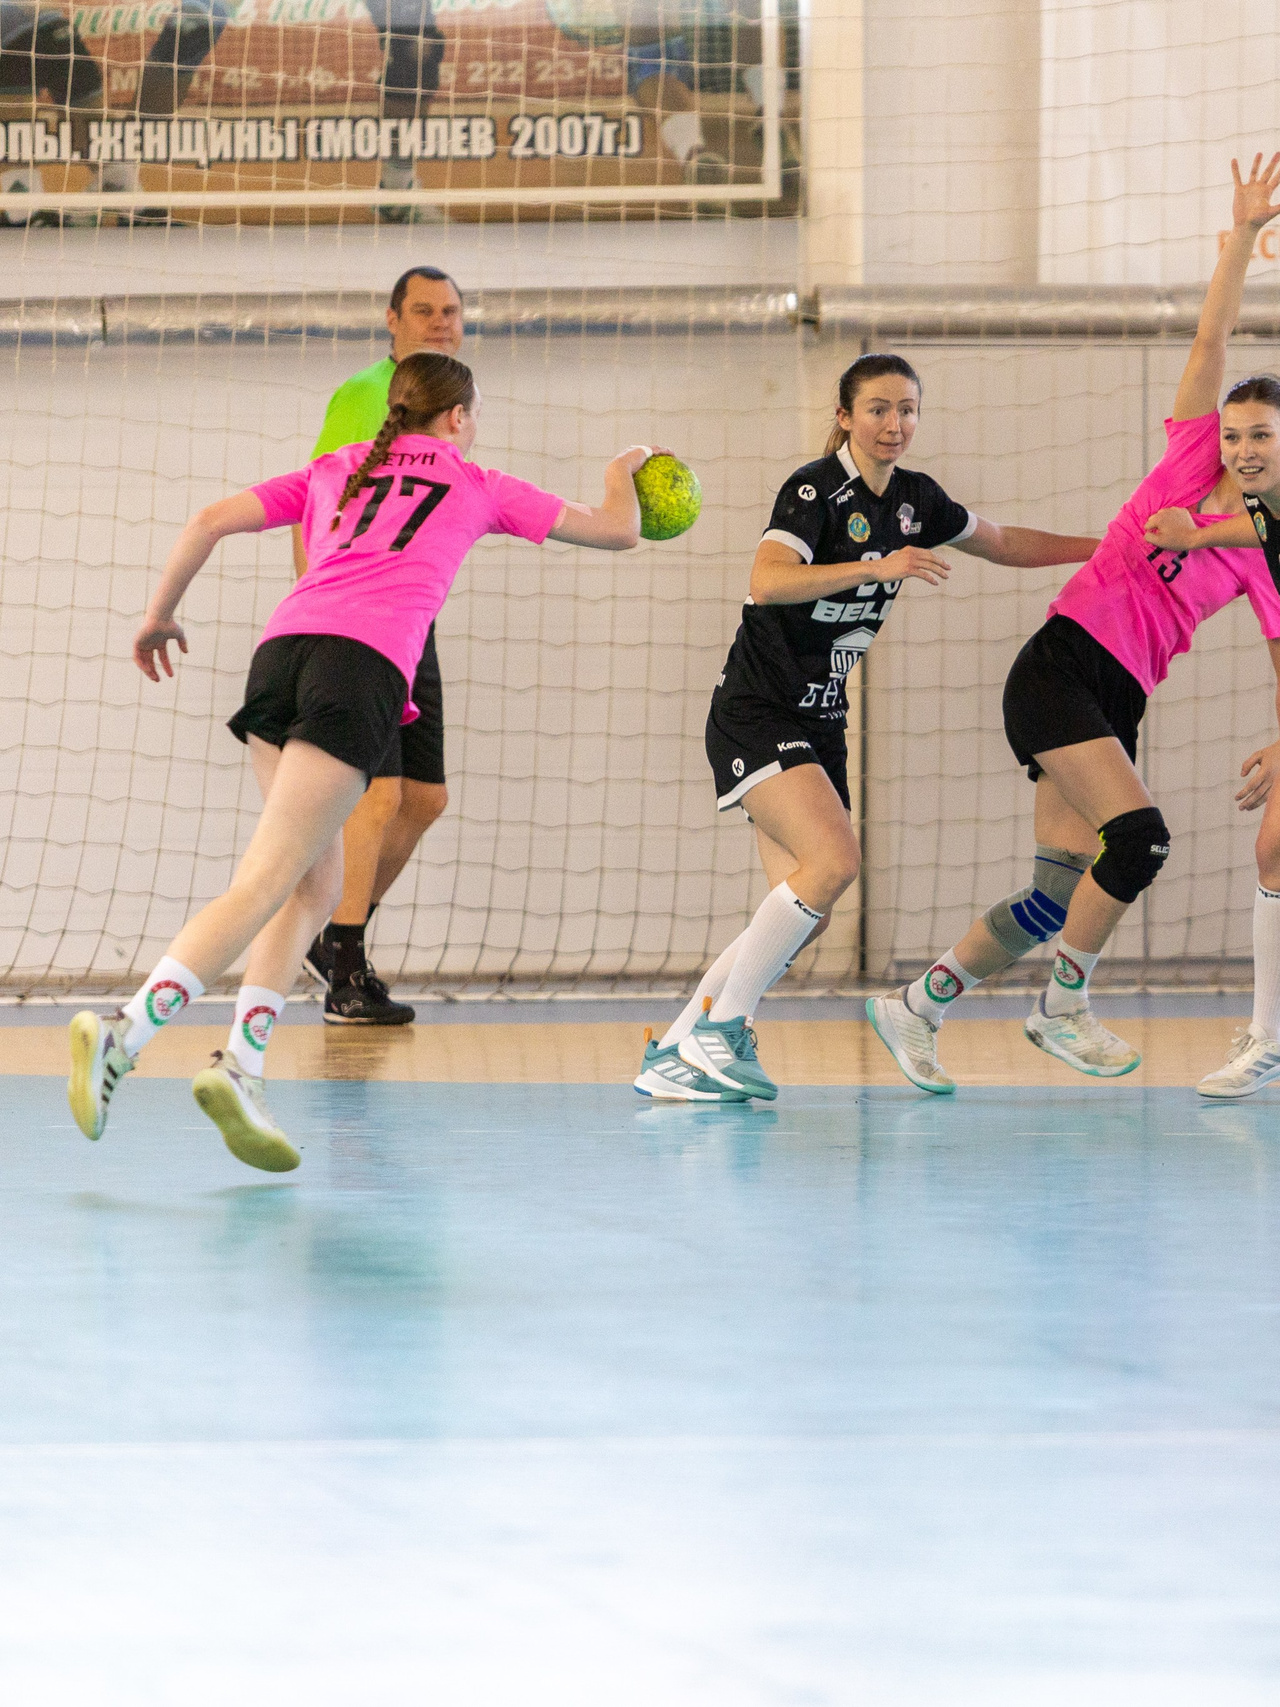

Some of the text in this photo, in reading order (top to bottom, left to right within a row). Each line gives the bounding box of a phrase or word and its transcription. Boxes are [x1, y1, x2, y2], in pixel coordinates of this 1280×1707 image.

[467, 59, 524, 84] 222
[0, 121, 82, 162] ПЫ.
[89, 120, 298, 167] ЖЕНЩИНЫ
[307, 118, 495, 161] (МОГИЛЕВ
[382, 452, 436, 466] ЕТУН
[338, 474, 451, 552] 77
[1150, 845, 1169, 854] SELEC
[793, 899, 822, 920] Kem
